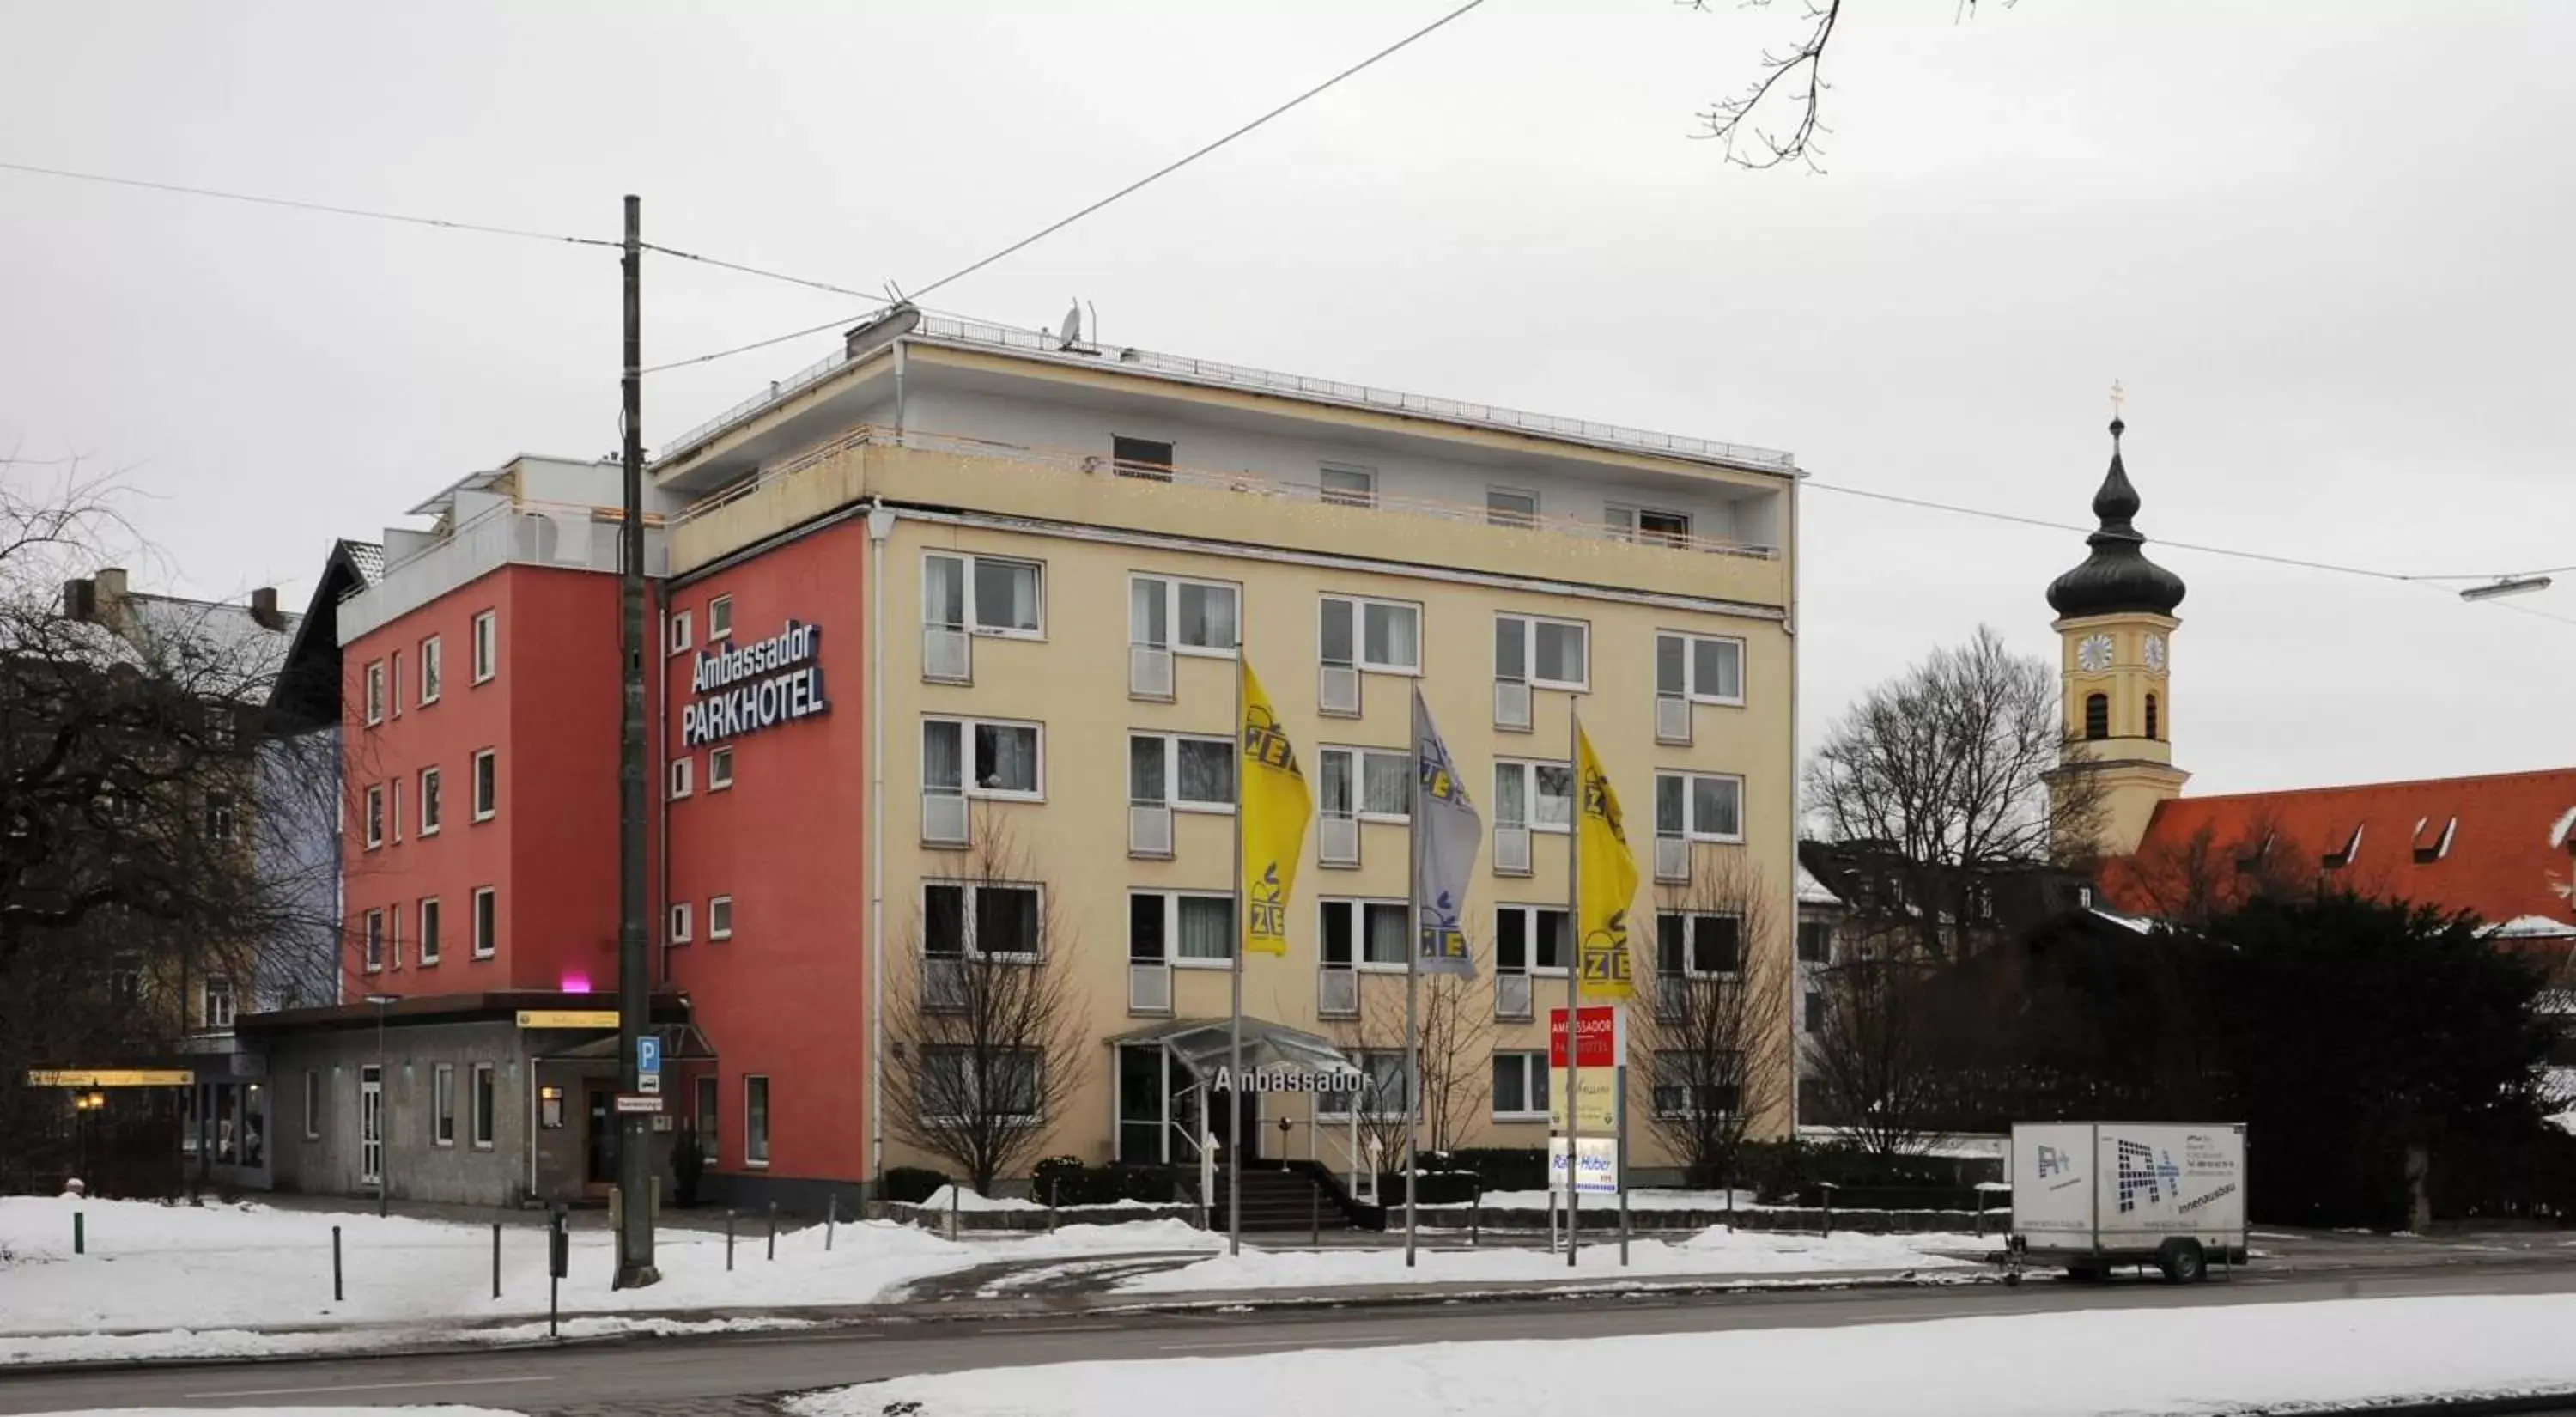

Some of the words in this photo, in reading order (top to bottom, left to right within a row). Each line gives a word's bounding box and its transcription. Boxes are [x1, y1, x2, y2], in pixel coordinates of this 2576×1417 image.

[691, 618, 817, 695] Ambassador
[683, 666, 824, 748] PARKHOTEL
[1552, 1019, 1612, 1034] AMBSSADOR
[641, 1041, 655, 1068] P
